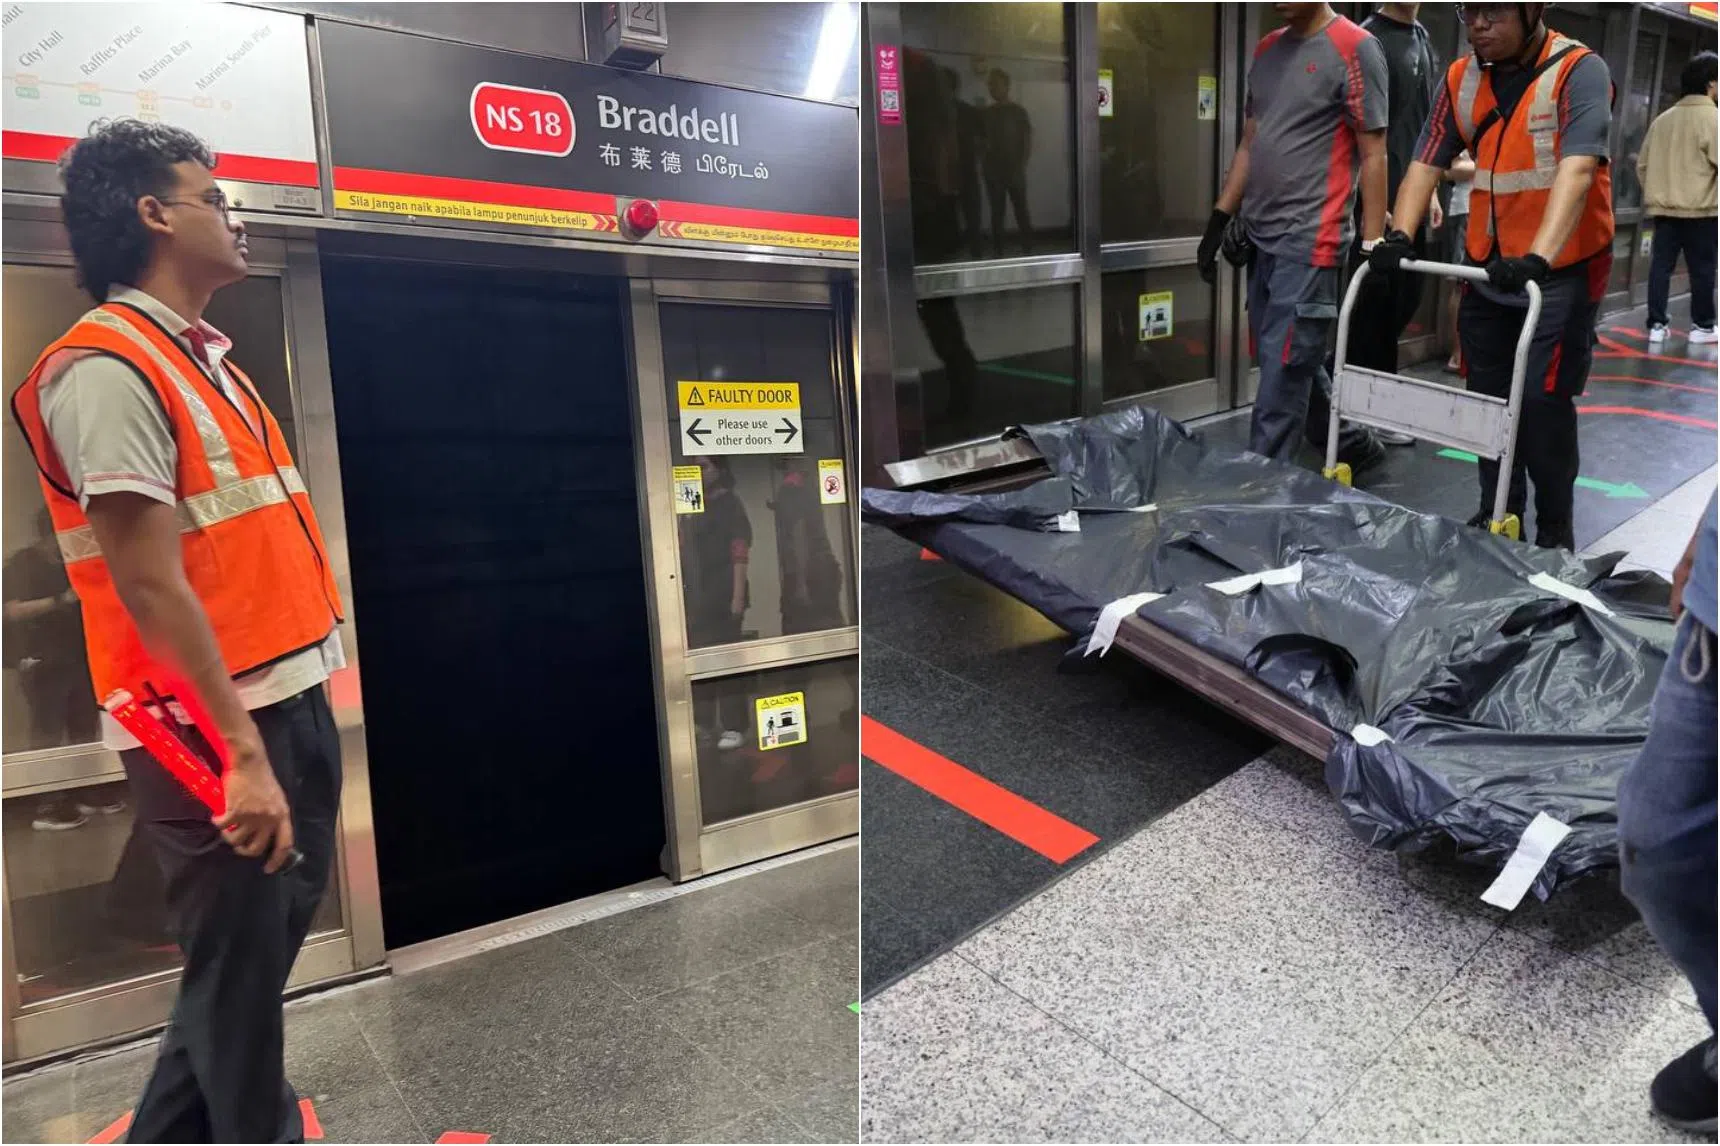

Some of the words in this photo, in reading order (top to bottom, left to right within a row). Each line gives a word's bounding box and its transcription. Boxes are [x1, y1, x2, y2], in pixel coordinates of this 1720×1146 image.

[18, 48, 43, 67] City
[38, 30, 64, 51] Hall
[79, 43, 118, 76] Raffles
[113, 24, 144, 52] Place
[137, 53, 171, 83] Marina
[169, 37, 194, 60] Bay
[194, 60, 228, 91] Marina
[226, 39, 257, 68] South
[250, 24, 273, 46] Pier
[486, 105, 523, 133] NS
[529, 109, 563, 137] 18
[597, 94, 740, 146] Braddell
[599, 142, 682, 175] 布莱德
[696, 153, 769, 180] பிரேடல்
[349, 195, 369, 207] Sila
[372, 197, 408, 211] jangan
[411, 201, 432, 213] naik
[435, 204, 472, 216] apabila
[474, 206, 504, 220] lampu
[506, 210, 551, 224] penunjuk
[551, 214, 588, 228] berkelip
[708, 389, 754, 404] FAULTY
[758, 389, 793, 404] DOOR
[716, 434, 743, 446] other
[745, 434, 773, 446] doors
[718, 419, 750, 430] Please
[752, 420, 769, 430] use
